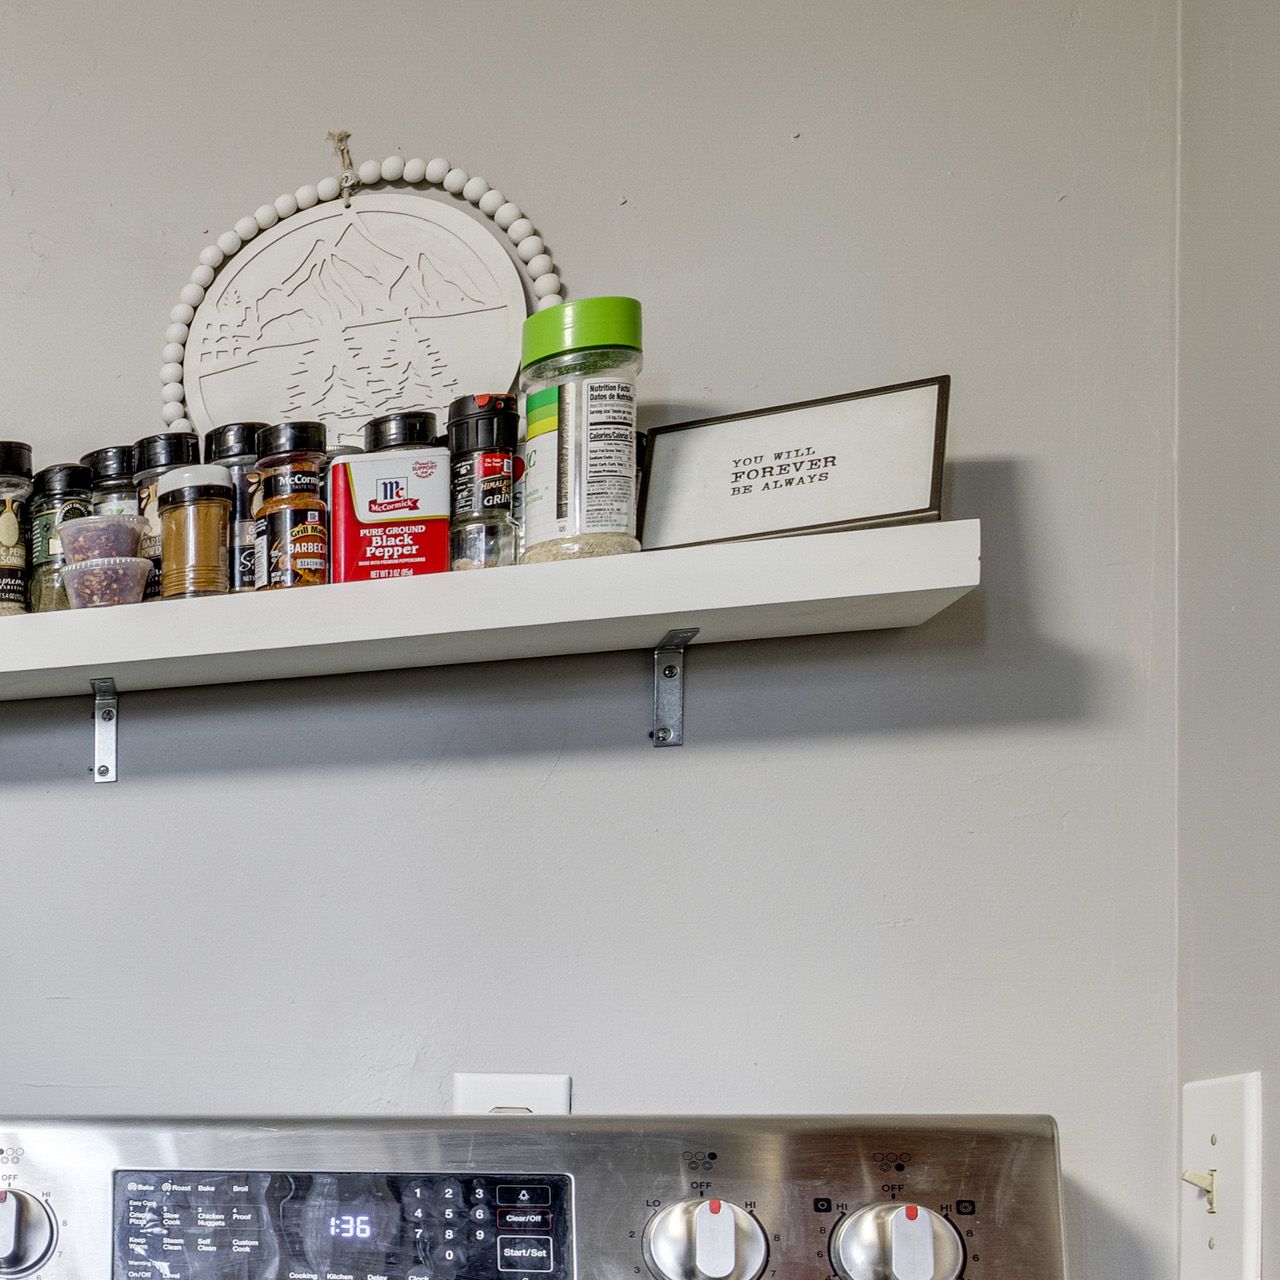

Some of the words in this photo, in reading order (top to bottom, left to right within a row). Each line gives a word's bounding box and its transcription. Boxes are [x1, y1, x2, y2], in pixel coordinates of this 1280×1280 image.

[589, 384, 617, 393] Nutrition
[589, 393, 608, 401] Datos
[609, 393, 616, 401] de
[732, 456, 764, 468] YOU
[774, 447, 815, 460] WILL
[731, 456, 837, 483] FOREVER
[731, 485, 752, 496] BE
[762, 472, 829, 491] ALWAYS
[370, 499, 414, 512] McCormick
[290, 525, 309, 537] Grill
[360, 529, 384, 537] PURE
[385, 525, 425, 534] GROUND
[372, 534, 414, 546] Black
[366, 545, 419, 559] Pepper
[370, 570, 380, 578] NET
[381, 569, 388, 578] WT
[393, 569, 400, 577] OZ
[691, 1181, 712, 1190] OFF
[881, 1184, 904, 1193] OFF
[415, 1188, 421, 1198] 1
[444, 1188, 453, 1198] 2
[475, 1189, 483, 1198] 3
[646, 1200, 661, 1208] LO
[745, 1201, 756, 1209] HI
[836, 1203, 848, 1211] HI
[940, 1204, 953, 1212] HI
[414, 1209, 422, 1218] 4
[445, 1209, 453, 1218] 5
[475, 1209, 484, 1219] 6
[506, 1214, 542, 1223] Clear/Off
[330, 1216, 370, 1237] 1:36
[415, 1229, 422, 1238] 7
[445, 1230, 453, 1239] 8
[476, 1230, 484, 1239] 9
[129, 1237, 146, 1245] Keep
[445, 1250, 453, 1260] 0
[503, 1248, 547, 1258] Start/Set
[289, 1273, 318, 1280] Cooking
